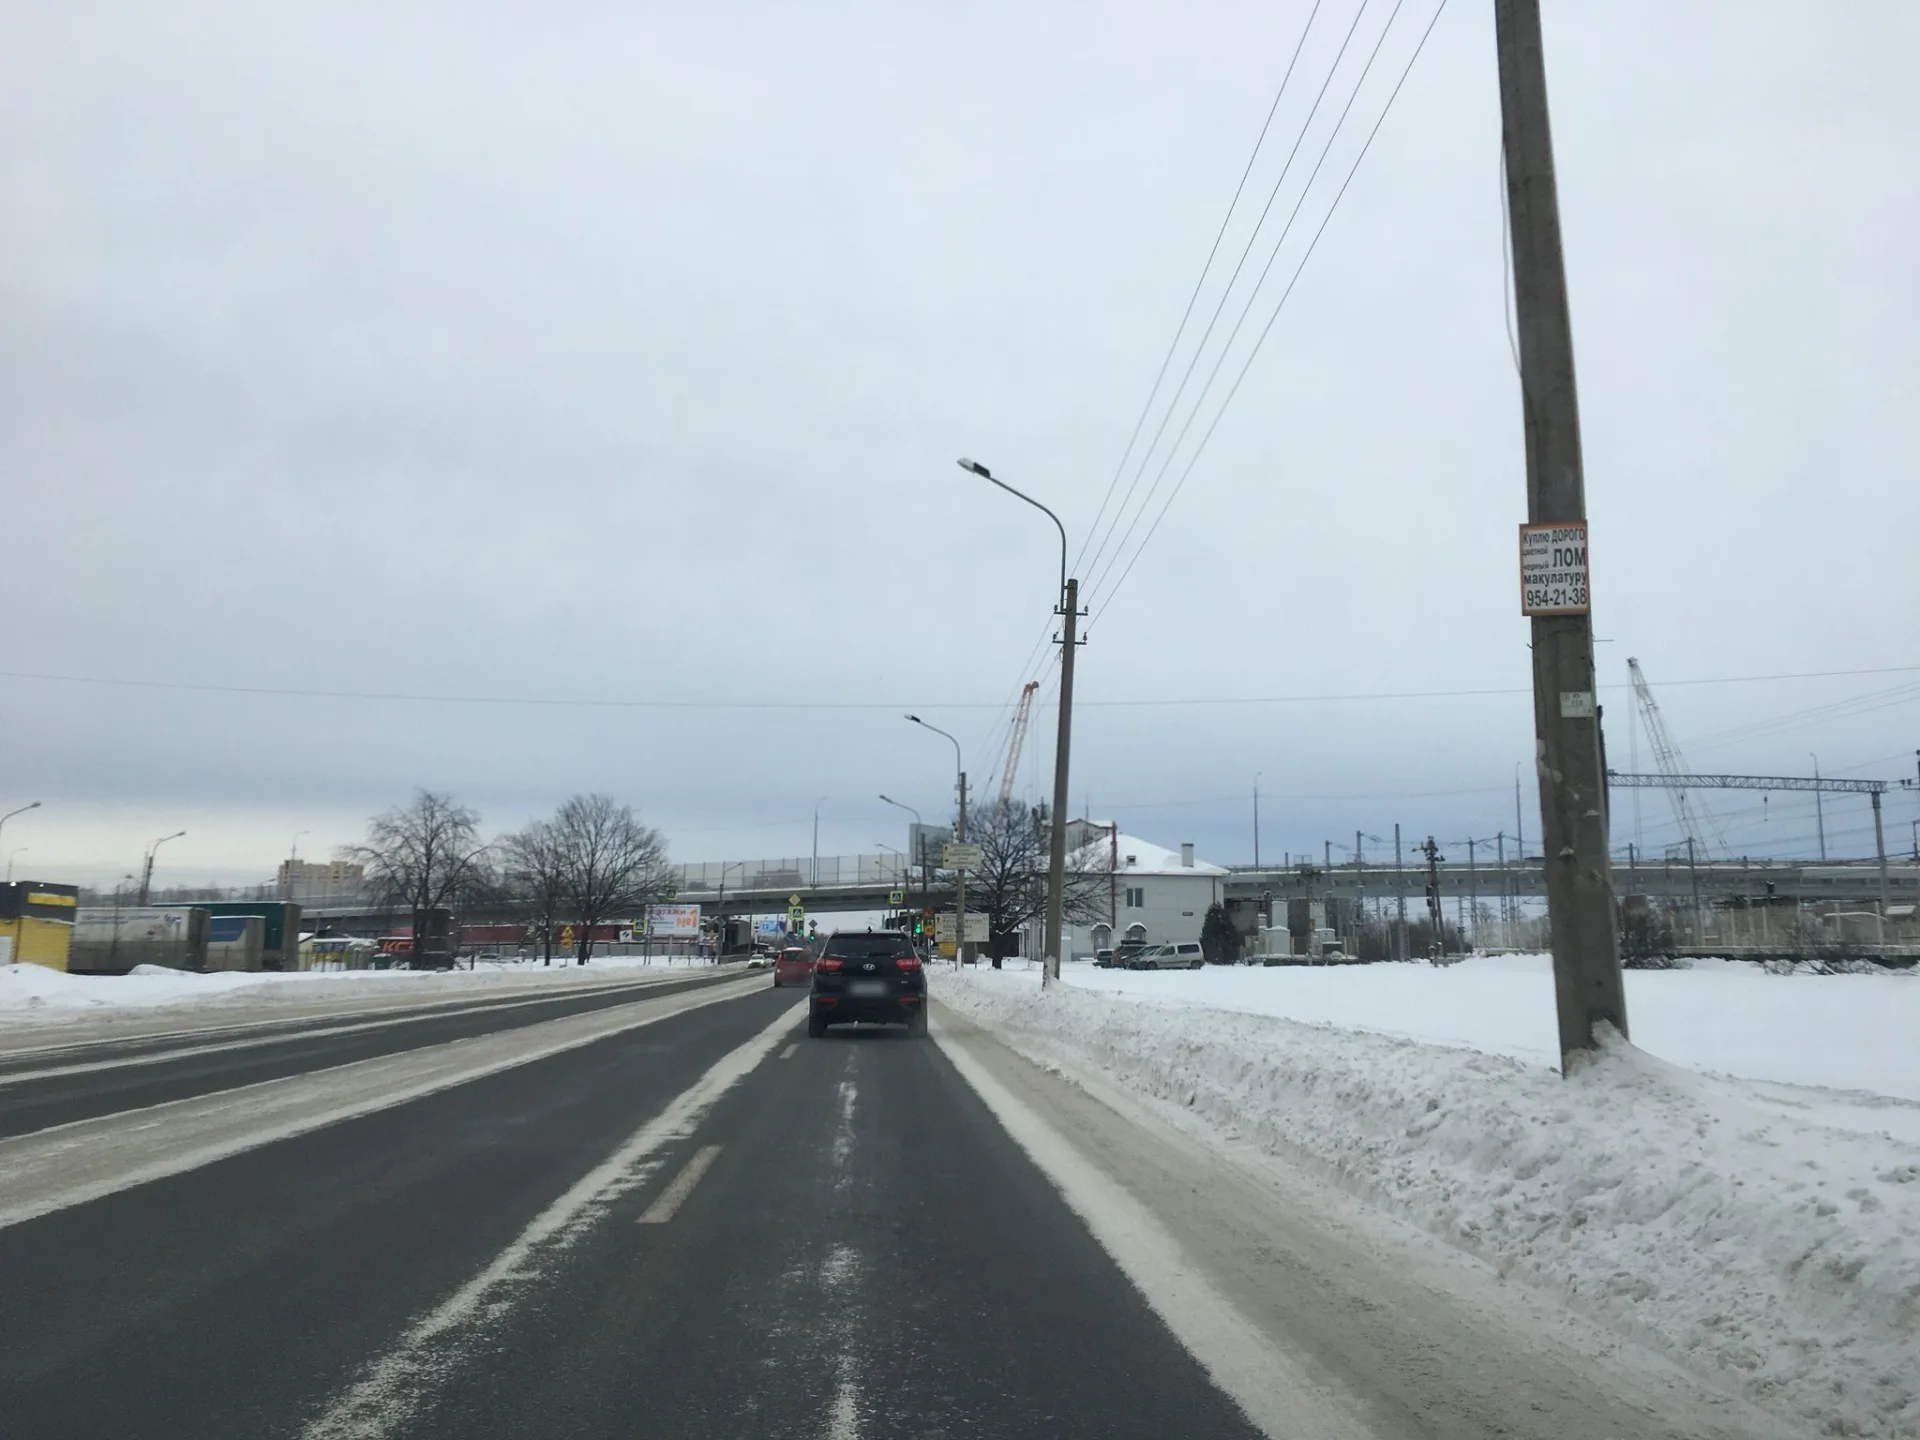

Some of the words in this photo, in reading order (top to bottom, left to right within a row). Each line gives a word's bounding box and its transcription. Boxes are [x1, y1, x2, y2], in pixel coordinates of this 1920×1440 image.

[1524, 532, 1549, 546] Куплю
[1552, 528, 1585, 544] ДОРОГО
[1553, 547, 1586, 567] ЛОМ
[1524, 572, 1586, 587] макулатуру
[1527, 587, 1587, 607] 954-21-38
